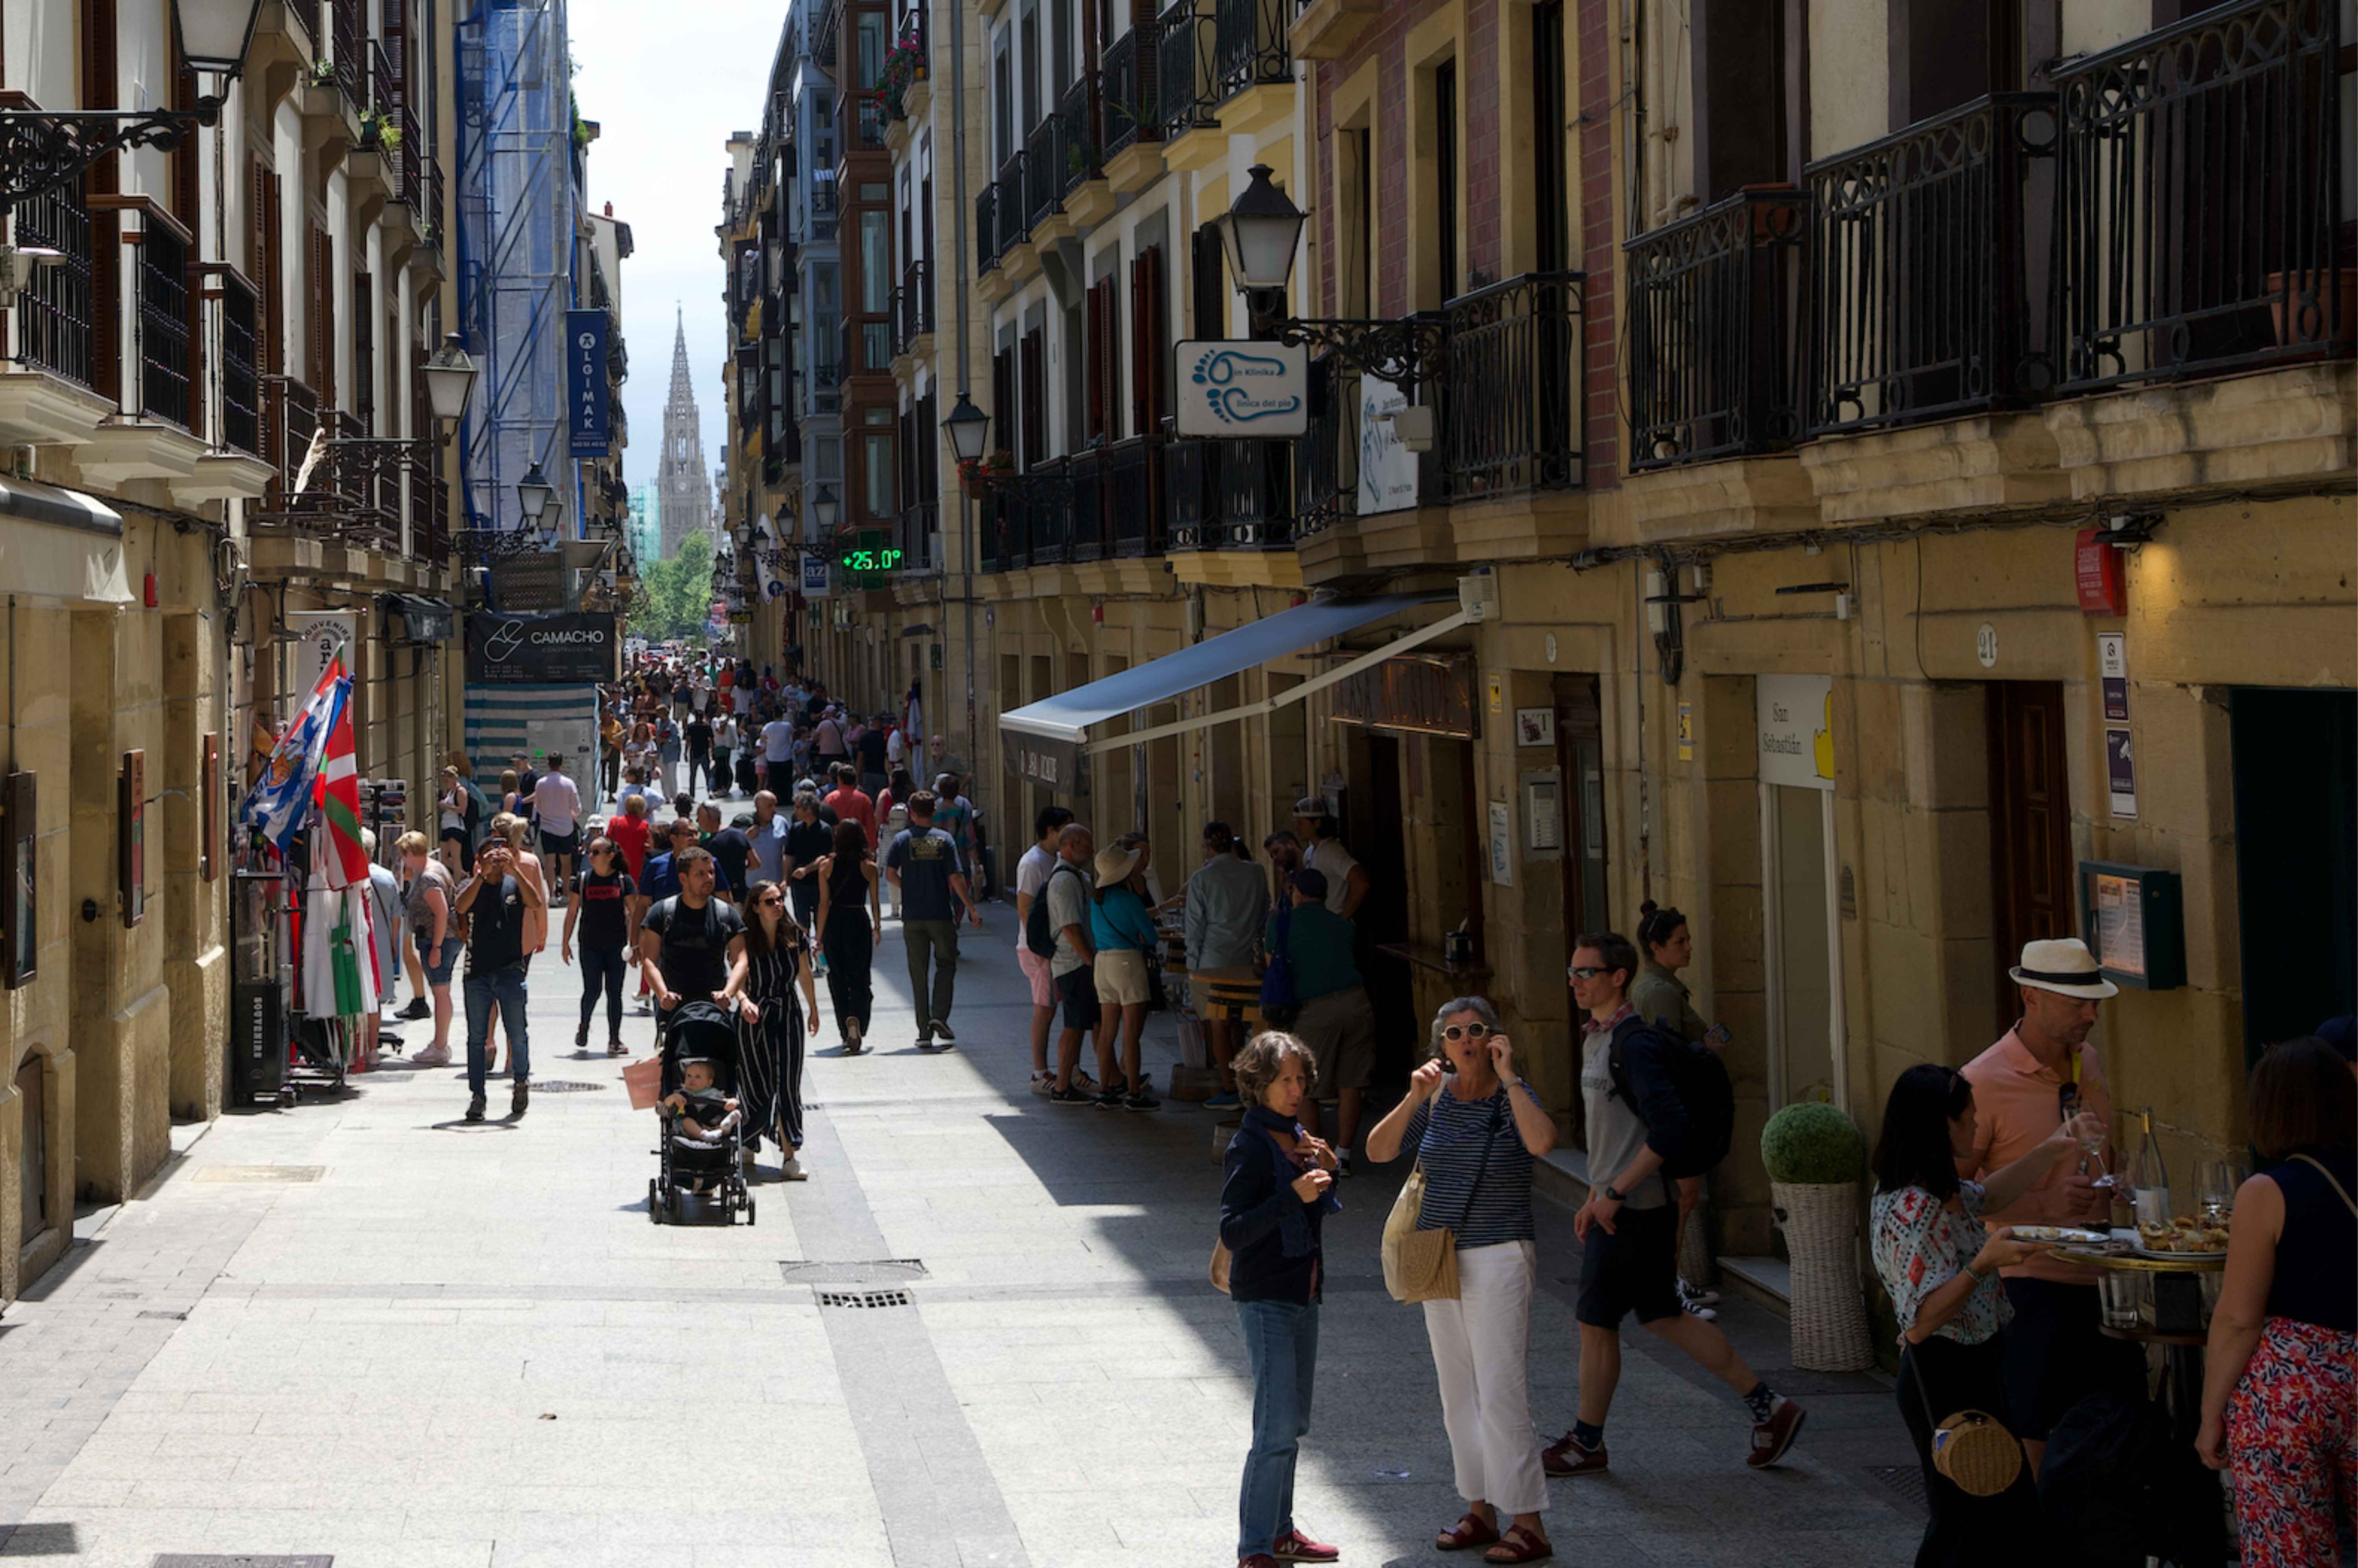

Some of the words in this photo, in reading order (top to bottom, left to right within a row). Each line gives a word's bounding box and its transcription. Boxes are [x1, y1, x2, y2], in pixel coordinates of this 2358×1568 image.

[1278, 400, 1291, 409] pie
[806, 566, 825, 577] az
[531, 630, 604, 644] CAMACHO
[1773, 702, 1789, 722] San
[1763, 733, 1802, 754] Sebastián
[253, 996, 263, 1059] SOUVENIRS
